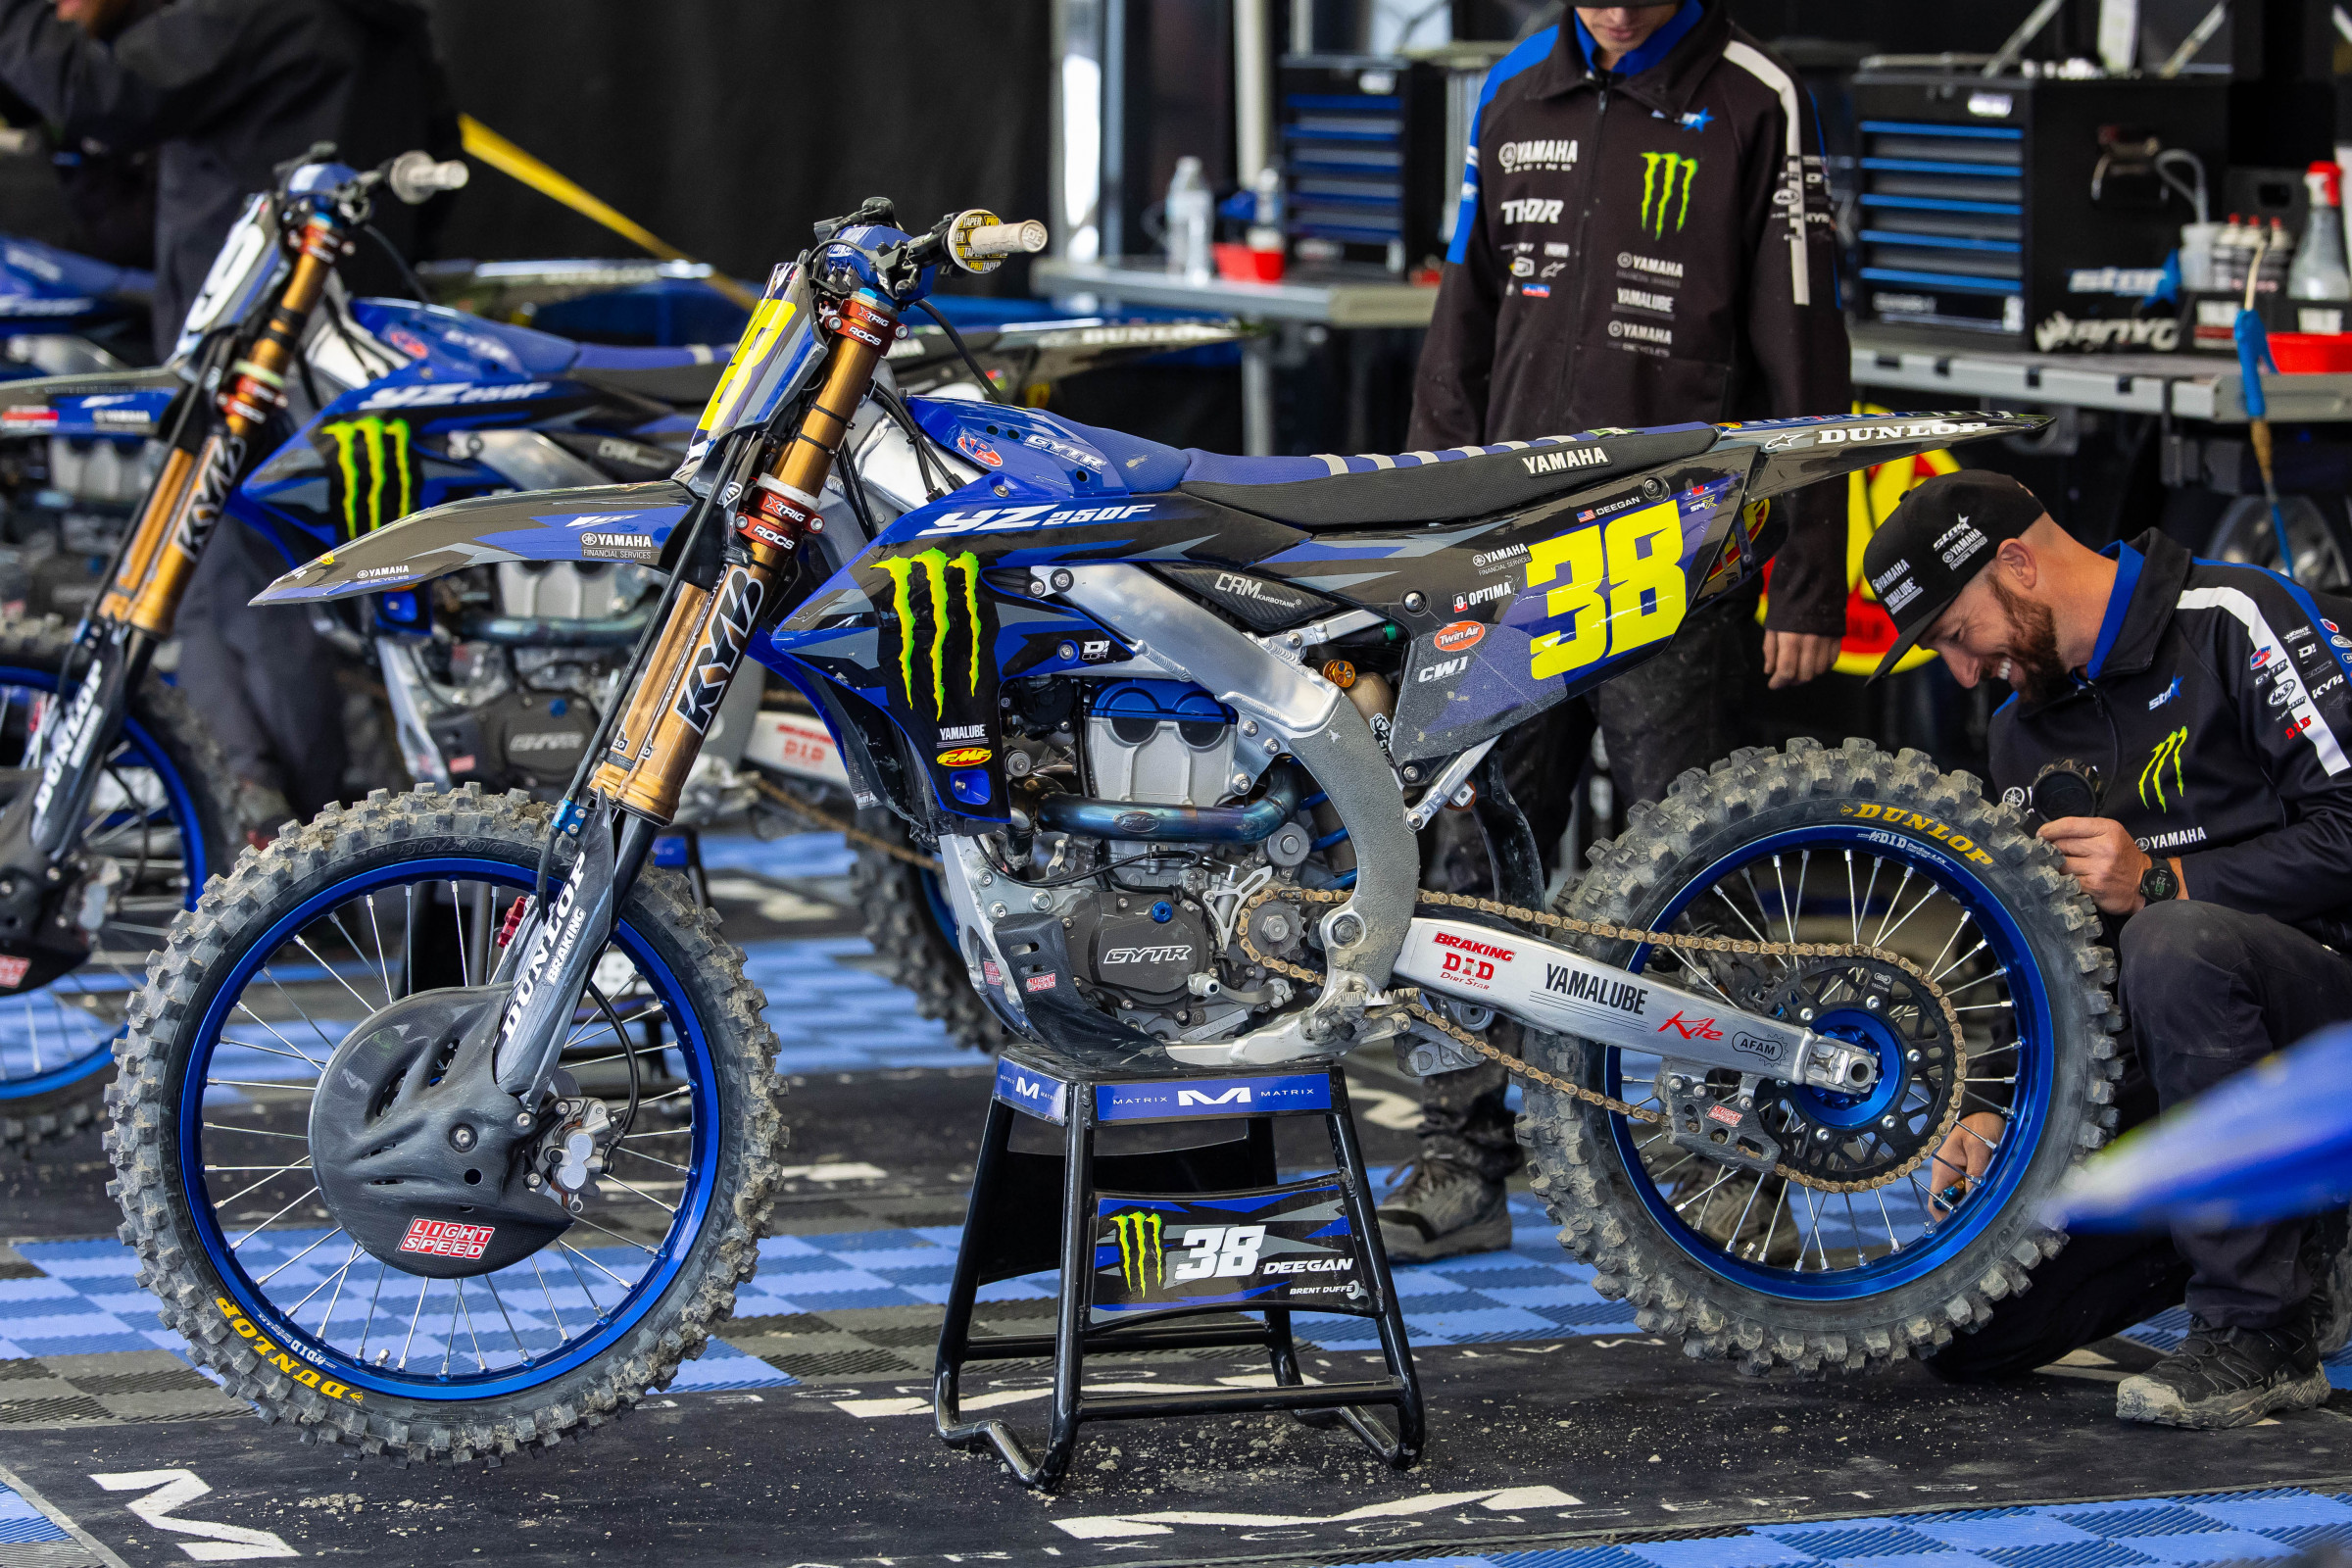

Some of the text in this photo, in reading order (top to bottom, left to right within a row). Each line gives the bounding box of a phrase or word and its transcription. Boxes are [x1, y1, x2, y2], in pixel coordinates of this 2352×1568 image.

[1517, 140, 1578, 163] YAMAHA
[1500, 198, 1564, 225] THOR
[1633, 255, 1684, 278] YAMAHA
[1617, 286, 1674, 314] YAMALUBE
[858, 305, 890, 327] XTRIG
[849, 325, 882, 346] ROCS
[1623, 322, 1672, 345] YAMAHA
[1818, 422, 1987, 444] DUNLOP
[1024, 434, 1107, 472] GYTR
[1521, 447, 1609, 475] YAMAHA
[764, 494, 806, 523] XTRIG
[1595, 496, 1641, 515] DEEGAN
[915, 504, 1156, 537] YZ 250F
[597, 533, 652, 548] YAMAHA
[753, 525, 796, 550] ROCS
[1949, 528, 1983, 557] YAMAHA
[583, 549, 652, 560] FINANCIAL SERVICES
[1478, 555, 1532, 576] FINANCIAL SERVICES
[1485, 542, 1529, 564] YAMAHA
[368, 564, 410, 577] YAMAHA
[1878, 559, 1911, 590] YAMAHA
[1214, 572, 1263, 599] CRM
[1468, 581, 1512, 606] OPTIMA
[1525, 498, 1688, 681] 38
[1439, 624, 1481, 647] Twin Air
[672, 565, 764, 736] KYB
[2254, 659, 2288, 686] GYTR
[939, 724, 986, 741] YAMALUBE
[937, 748, 992, 764] FMF
[1852, 803, 1995, 866] DUNLOP
[2150, 826, 2207, 850] YAMAHA
[502, 851, 586, 1044] DUNLOP
[548, 907, 586, 983] BRAKING
[1102, 944, 1193, 964] GYTR
[1434, 931, 1516, 962] BRAKING
[1442, 952, 1494, 981] D.I.D
[1544, 962, 1649, 1015] YAMALUBE
[1657, 1010, 1724, 1041] Kite
[1740, 1038, 1776, 1055] AFAM
[1112, 1086, 1314, 1106] MATRIX M MATRIX
[412, 1218, 494, 1243] LIGHT
[401, 1236, 489, 1259] SPEED
[1174, 1225, 1266, 1280] 38
[1262, 1257, 1353, 1275] DEEGAN
[1290, 1287, 1321, 1296] BRENT
[215, 1296, 350, 1400] DUNLOP
